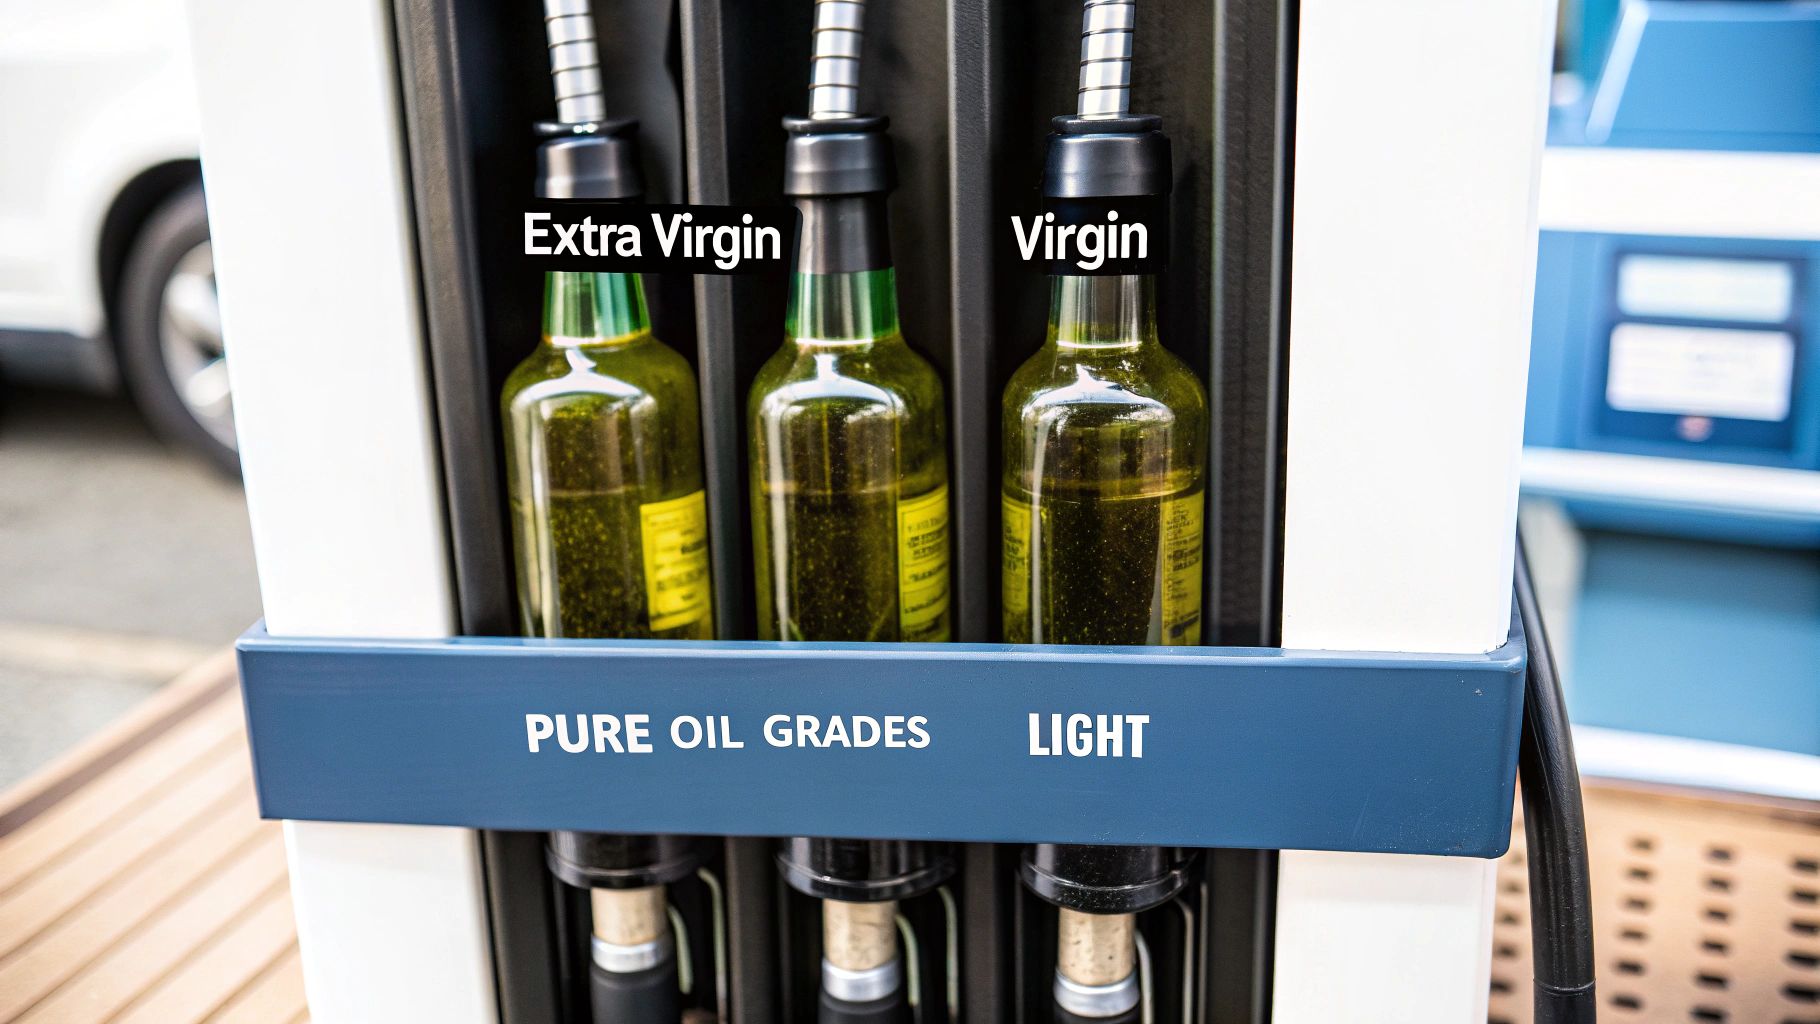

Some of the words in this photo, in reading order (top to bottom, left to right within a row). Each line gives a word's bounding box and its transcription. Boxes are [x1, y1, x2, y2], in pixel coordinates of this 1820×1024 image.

[524, 212, 643, 257] Extra
[651, 212, 781, 270] Virgin
[1010, 210, 1148, 271] Virgin
[525, 713, 654, 754] PURE
[670, 715, 745, 749] OIL
[763, 714, 931, 749] GRADES
[1028, 712, 1150, 758] LIGHT
